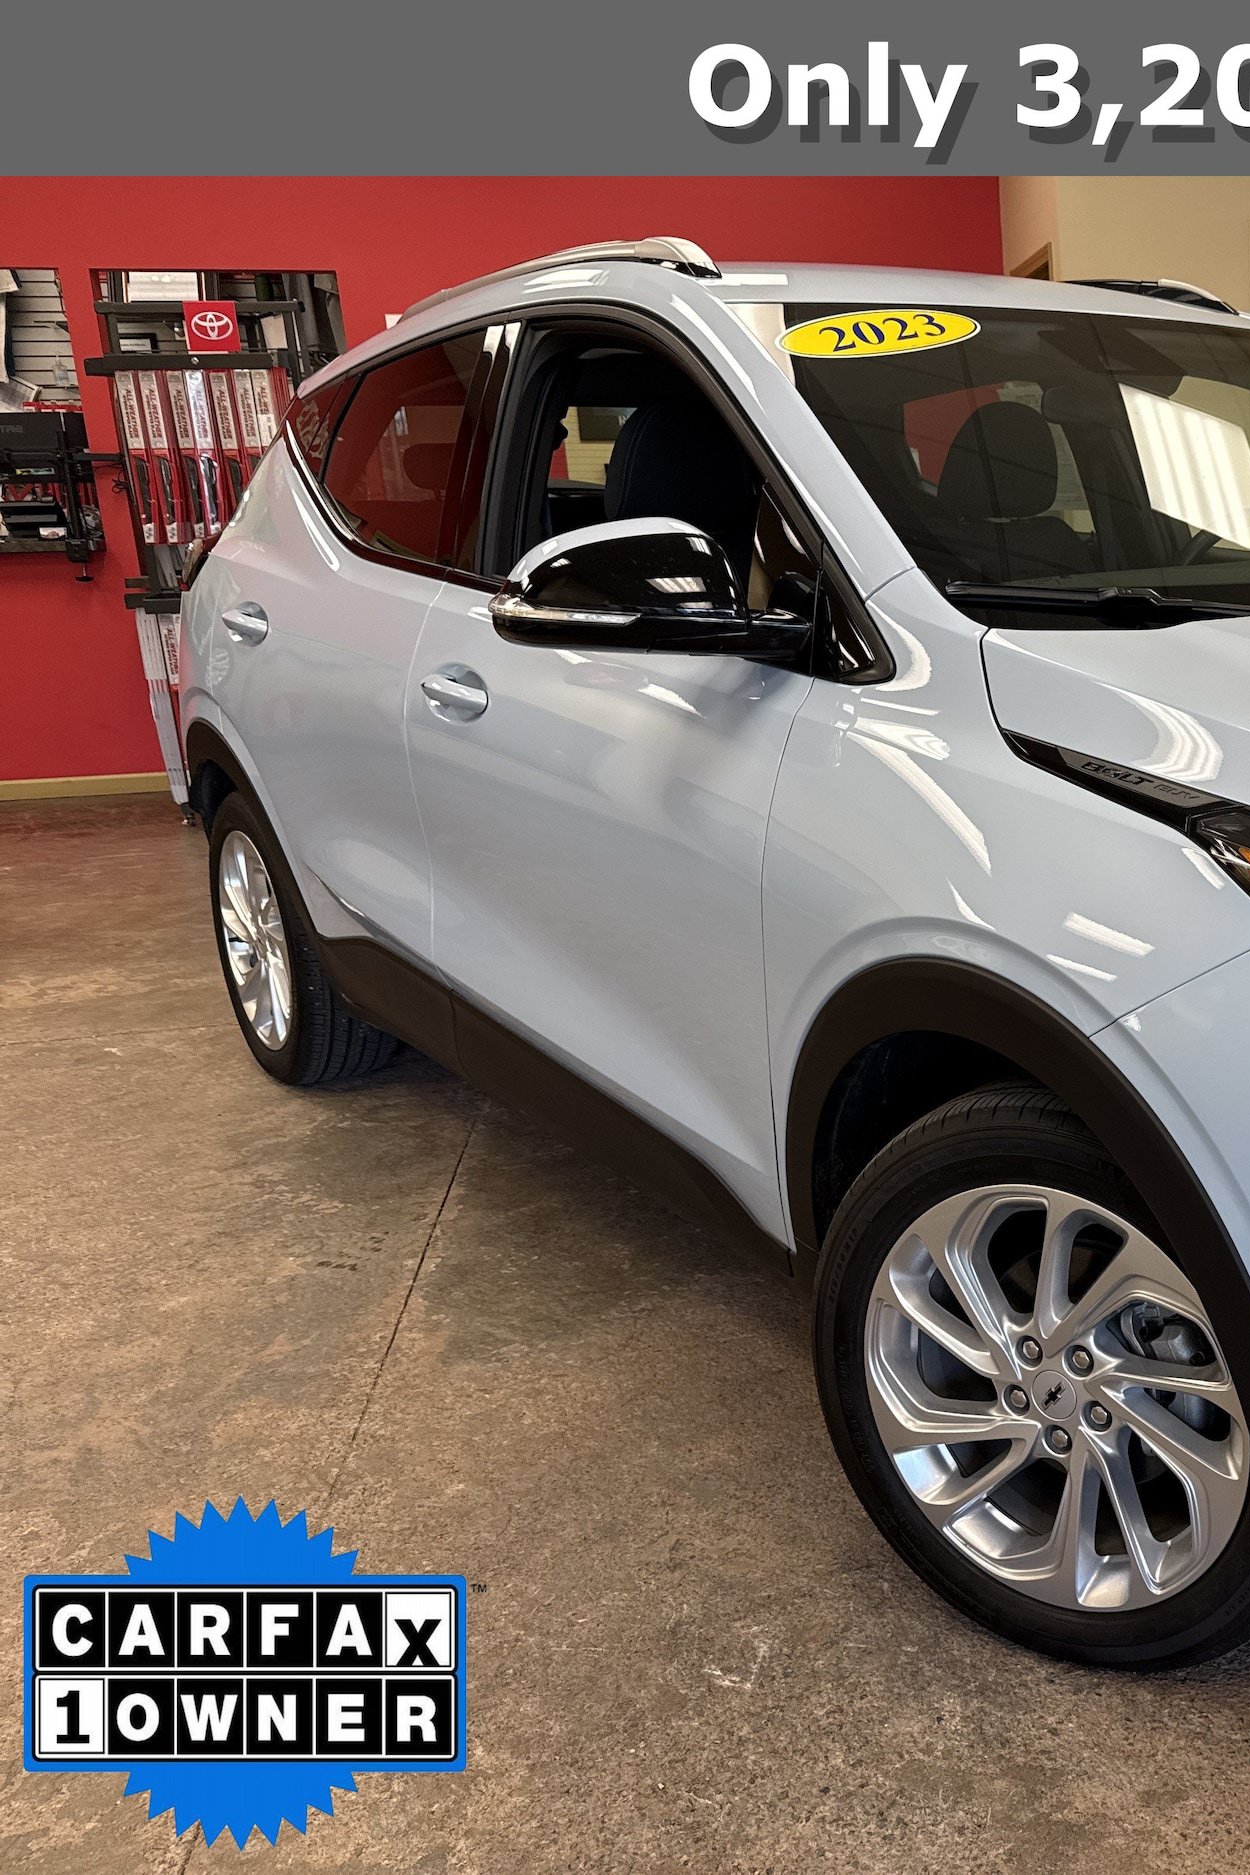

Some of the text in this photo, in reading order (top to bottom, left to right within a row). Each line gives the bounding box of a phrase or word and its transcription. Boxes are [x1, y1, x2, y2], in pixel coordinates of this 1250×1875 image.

[819, 313, 946, 352] 2023
[125, 388, 139, 438] ALL-WEATHER
[148, 388, 162, 438] ALL-WEATHER
[176, 389, 189, 438] ALL-WEATHER
[218, 388, 232, 439] ALL-WEATHER
[243, 387, 256, 437] ALL-WEATHER
